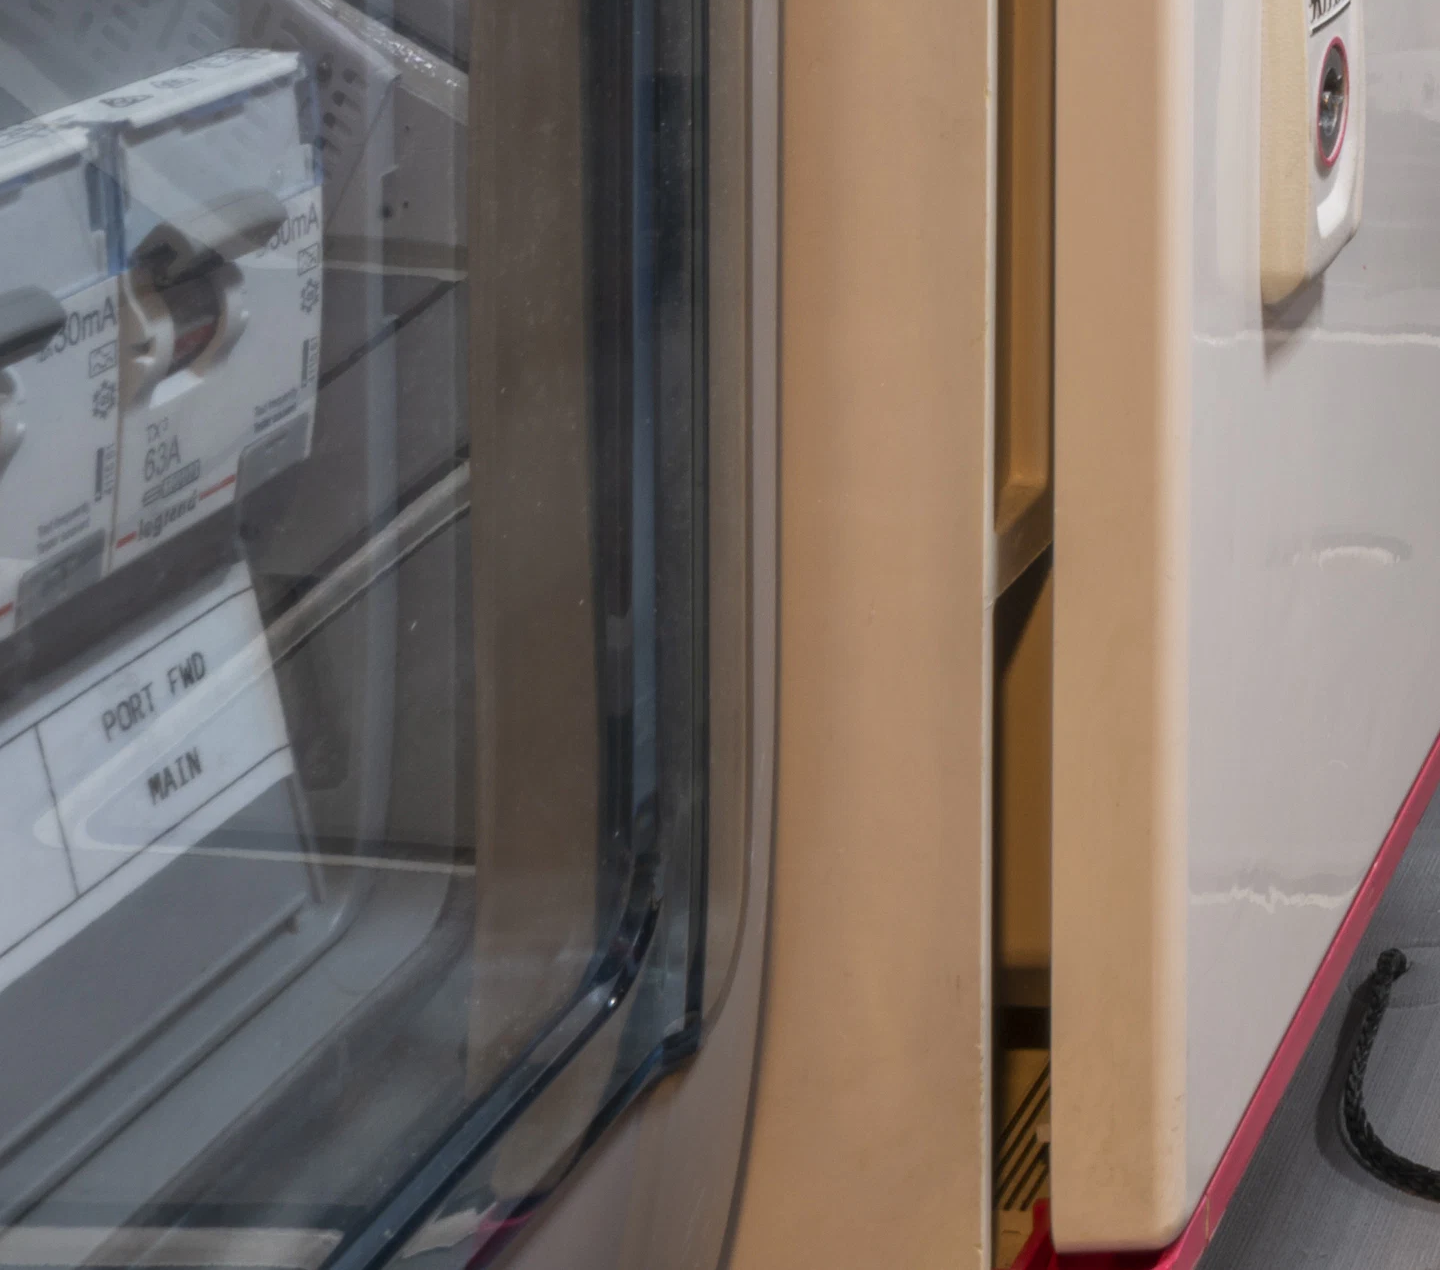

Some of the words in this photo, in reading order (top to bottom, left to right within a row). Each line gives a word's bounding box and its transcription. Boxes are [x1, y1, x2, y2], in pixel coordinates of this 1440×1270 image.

[144, 434, 181, 482] 63A
[137, 488, 198, 541] legrand
[100, 681, 157, 744] PORT
[166, 651, 208, 698] FWD
[146, 747, 203, 806] MAIN
